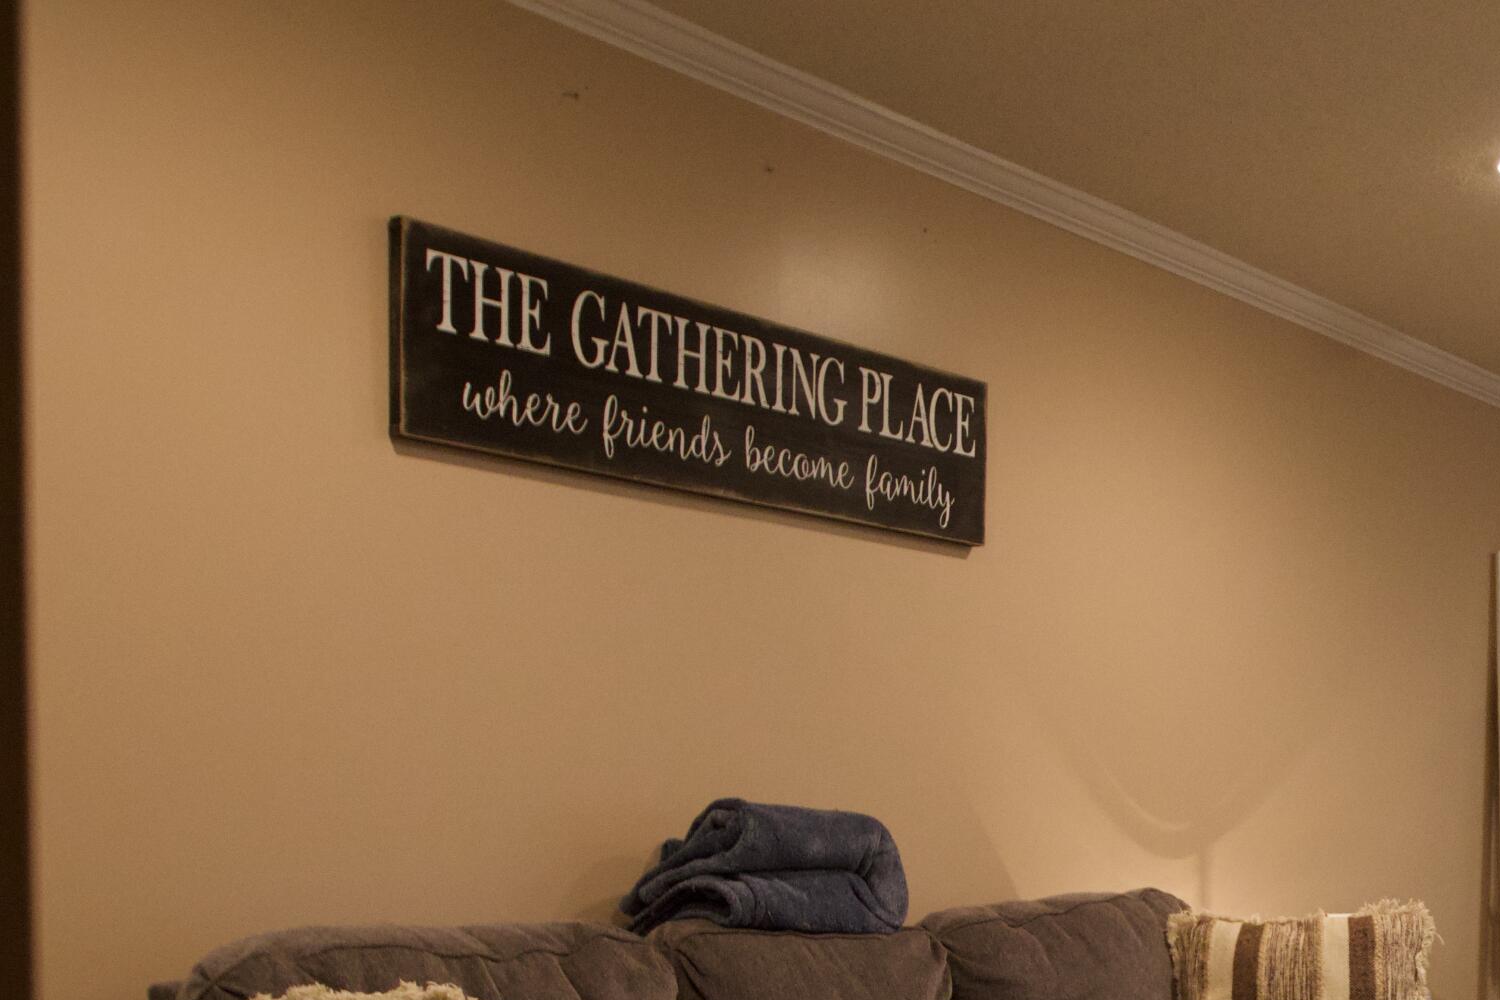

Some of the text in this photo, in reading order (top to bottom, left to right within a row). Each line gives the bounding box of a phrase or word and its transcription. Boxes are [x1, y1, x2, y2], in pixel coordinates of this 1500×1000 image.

[425, 248, 977, 458] THE GATHERING PLACE
[462, 369, 956, 529] where friends become family
